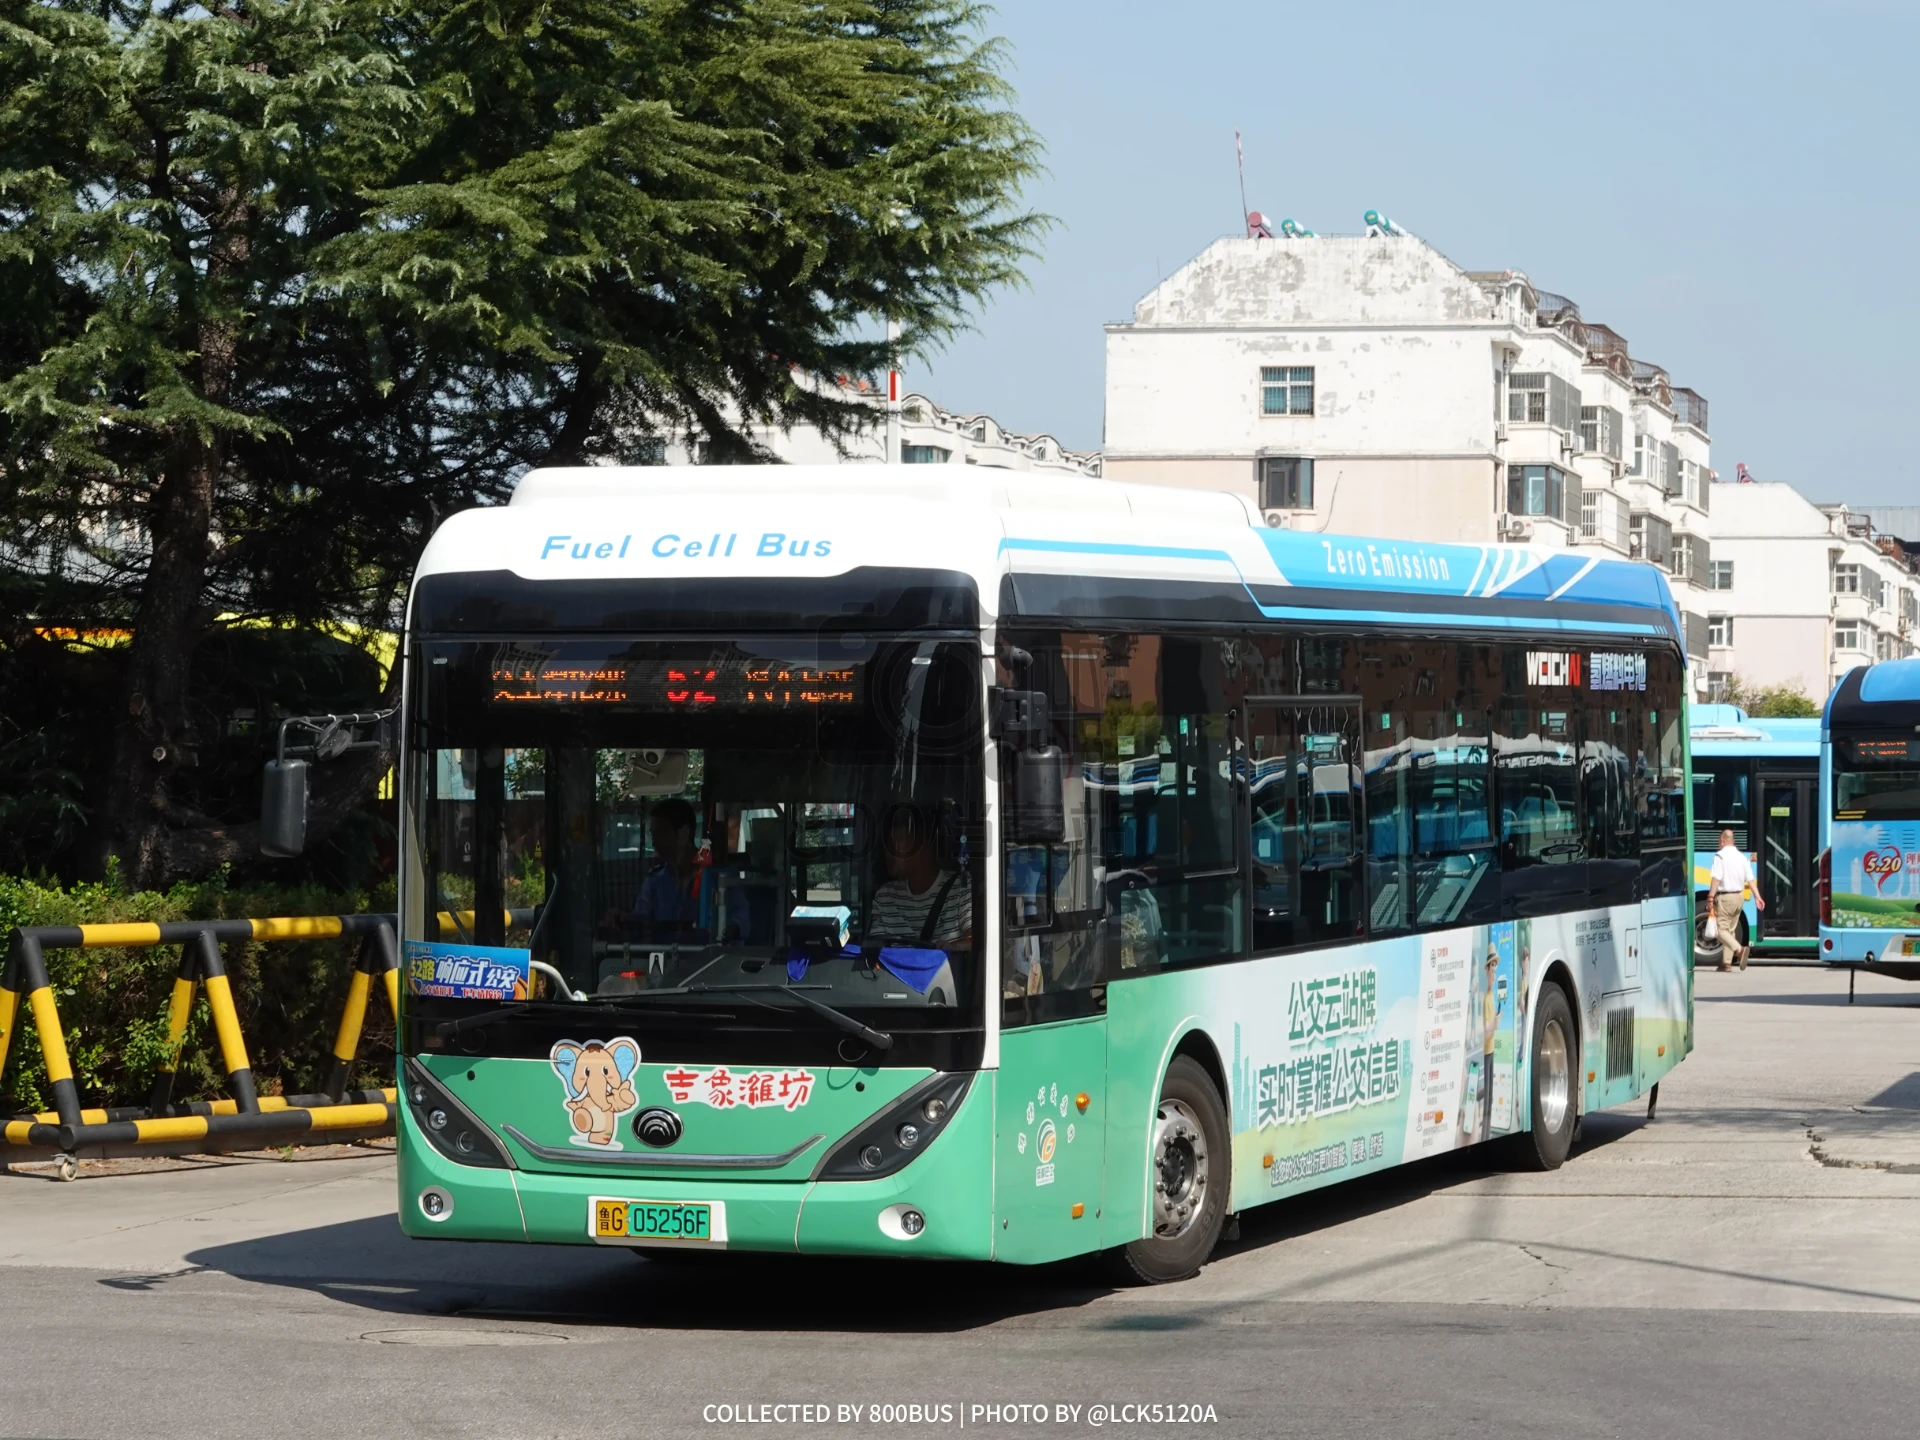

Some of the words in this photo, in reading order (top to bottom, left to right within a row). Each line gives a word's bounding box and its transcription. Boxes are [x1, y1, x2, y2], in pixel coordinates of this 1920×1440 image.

[540, 535, 632, 560] Fuel
[651, 534, 738, 558] Cell
[756, 533, 833, 557] Bus
[1321, 541, 1366, 576] Zero
[1367, 544, 1450, 581] Emission
[1866, 856, 1902, 873] 5.20
[410, 958, 436, 982] 52路
[436, 957, 517, 989] 响应式公交
[1287, 968, 1376, 1042] 公交云站牌
[1257, 1037, 1400, 1127] 实时掌握公交信息
